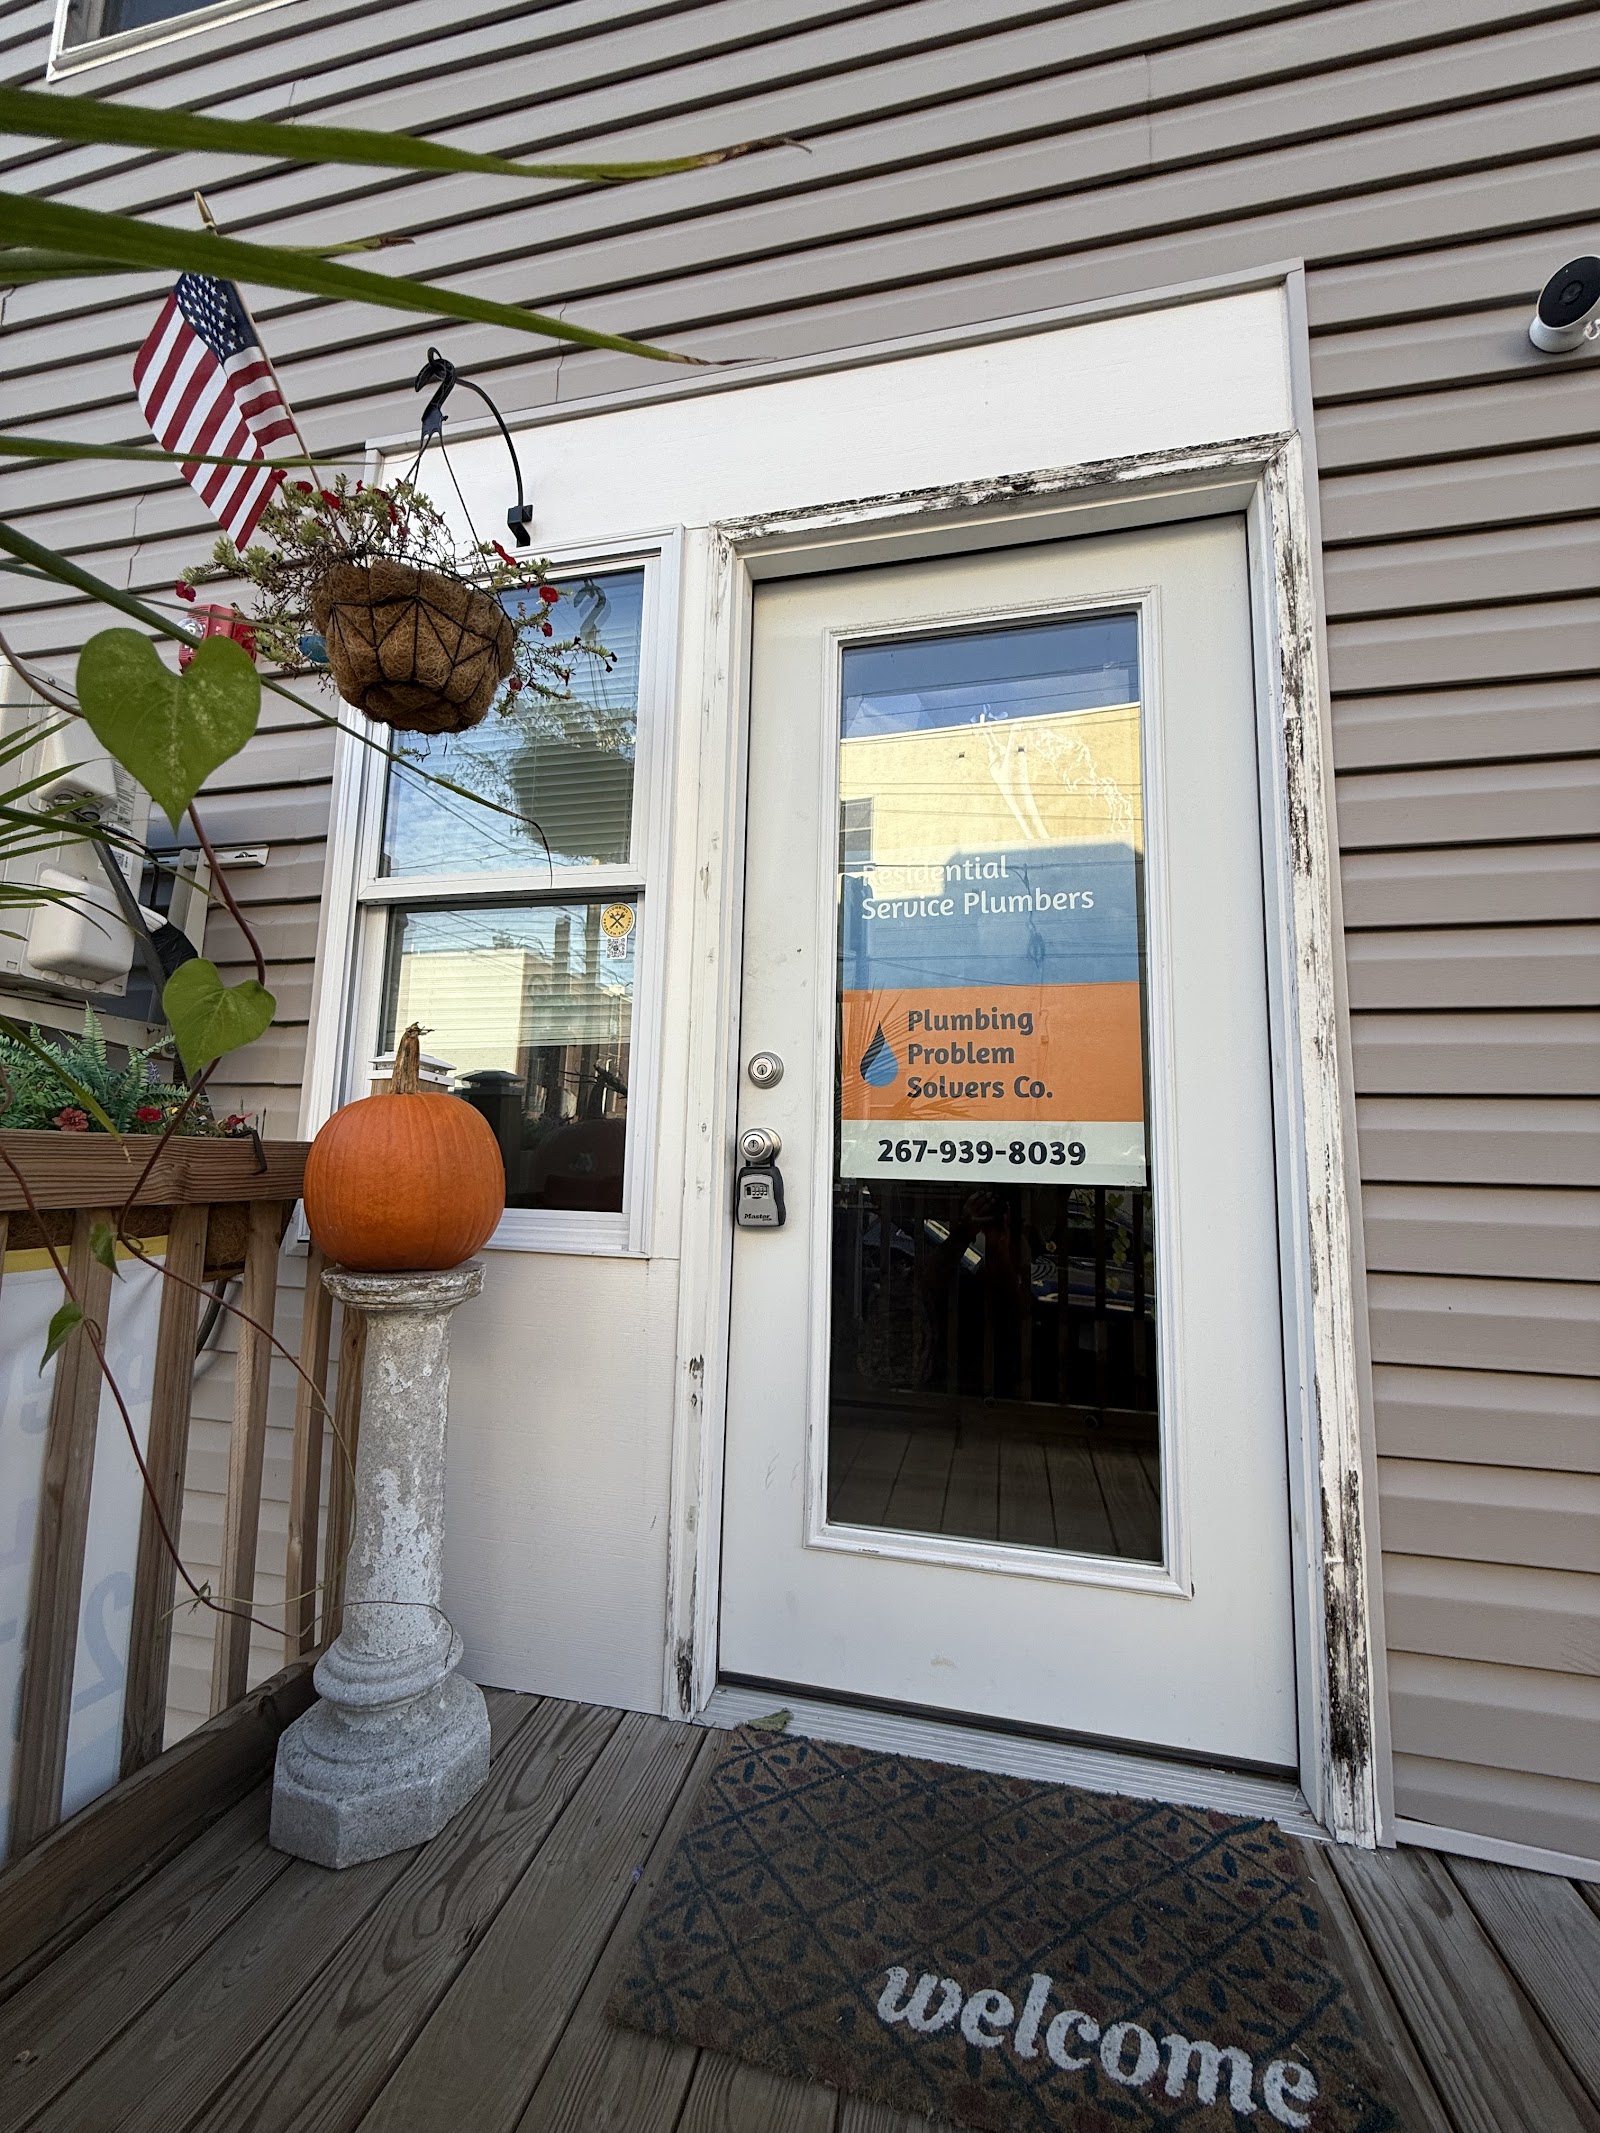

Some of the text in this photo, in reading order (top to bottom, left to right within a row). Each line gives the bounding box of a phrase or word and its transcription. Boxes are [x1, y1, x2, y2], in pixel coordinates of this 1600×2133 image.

[863, 855, 1009, 887] Residential
[862, 888, 1094, 920] Service Plumbers
[908, 1007, 1033, 1035] Plumbing
[908, 1042, 1014, 1065] Problem
[907, 1075, 1053, 1099] Solvers Co.
[878, 1139, 1086, 1165] 267-939-8039
[876, 1966, 1318, 2128] welcome
